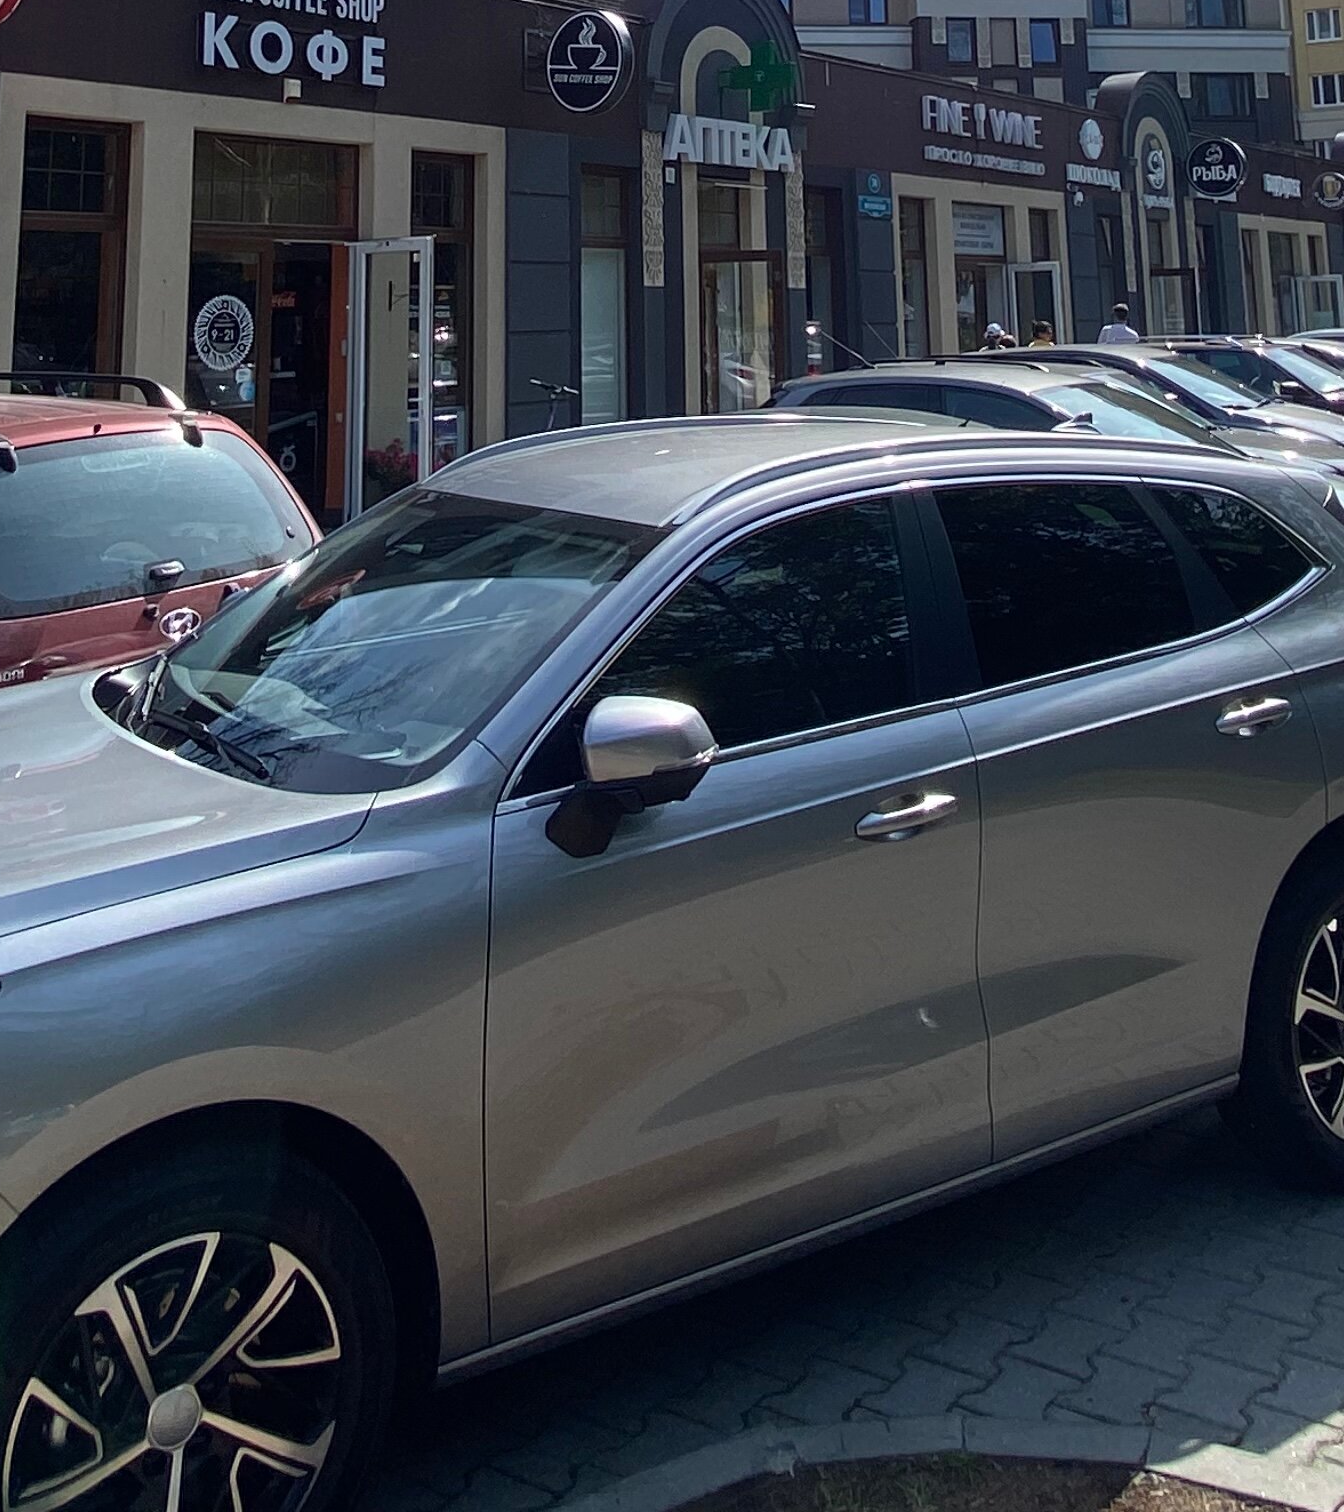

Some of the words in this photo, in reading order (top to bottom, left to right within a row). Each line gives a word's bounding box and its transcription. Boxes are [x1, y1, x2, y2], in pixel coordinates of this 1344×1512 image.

[203, 11, 386, 88] КОФЕ
[553, 74, 568, 83] SUN
[569, 74, 593, 84] COFFEE
[594, 75, 613, 84] SHOP
[664, 113, 795, 173] АПТЕКА
[922, 95, 972, 137] FINE
[989, 108, 1044, 149] WINE
[1192, 164, 1237, 182] РЫБА
